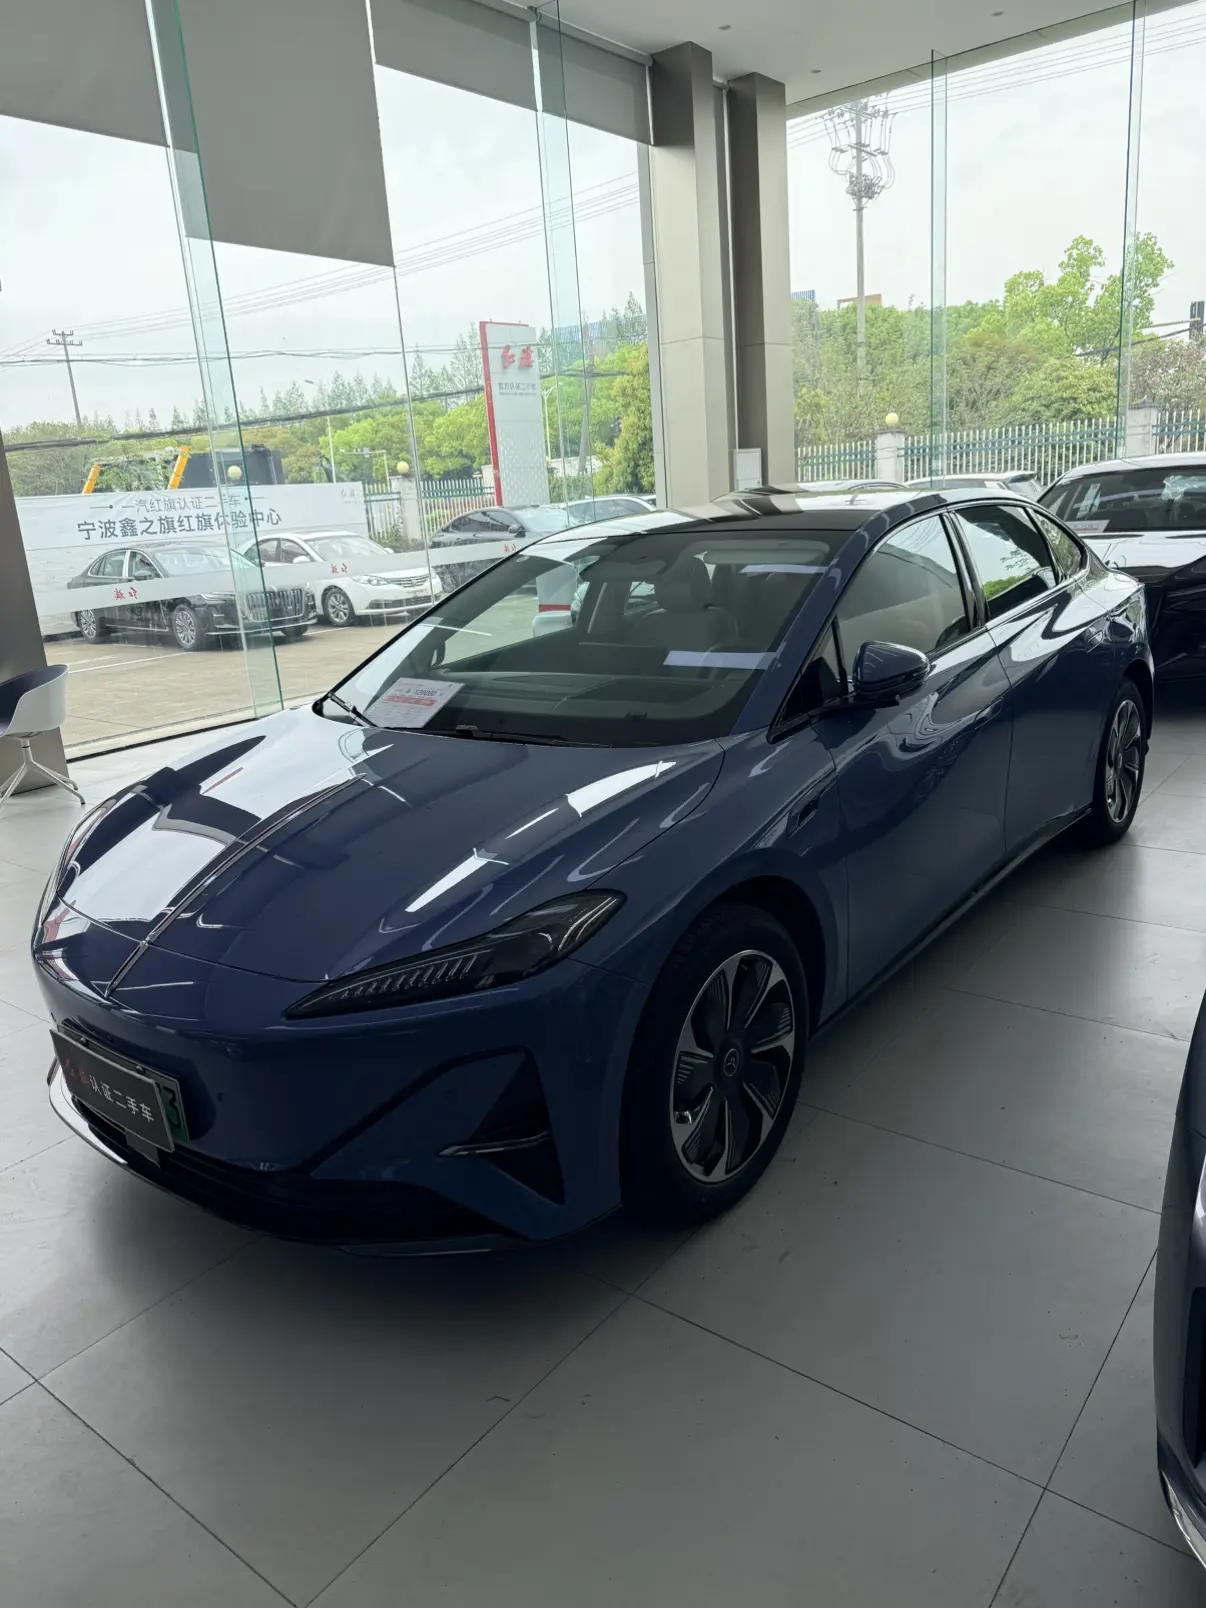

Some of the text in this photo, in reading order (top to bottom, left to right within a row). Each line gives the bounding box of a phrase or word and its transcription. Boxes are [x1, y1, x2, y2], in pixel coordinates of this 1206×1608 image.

[77, 508, 282, 541] 宁波鑫之旗红旗体验中心
